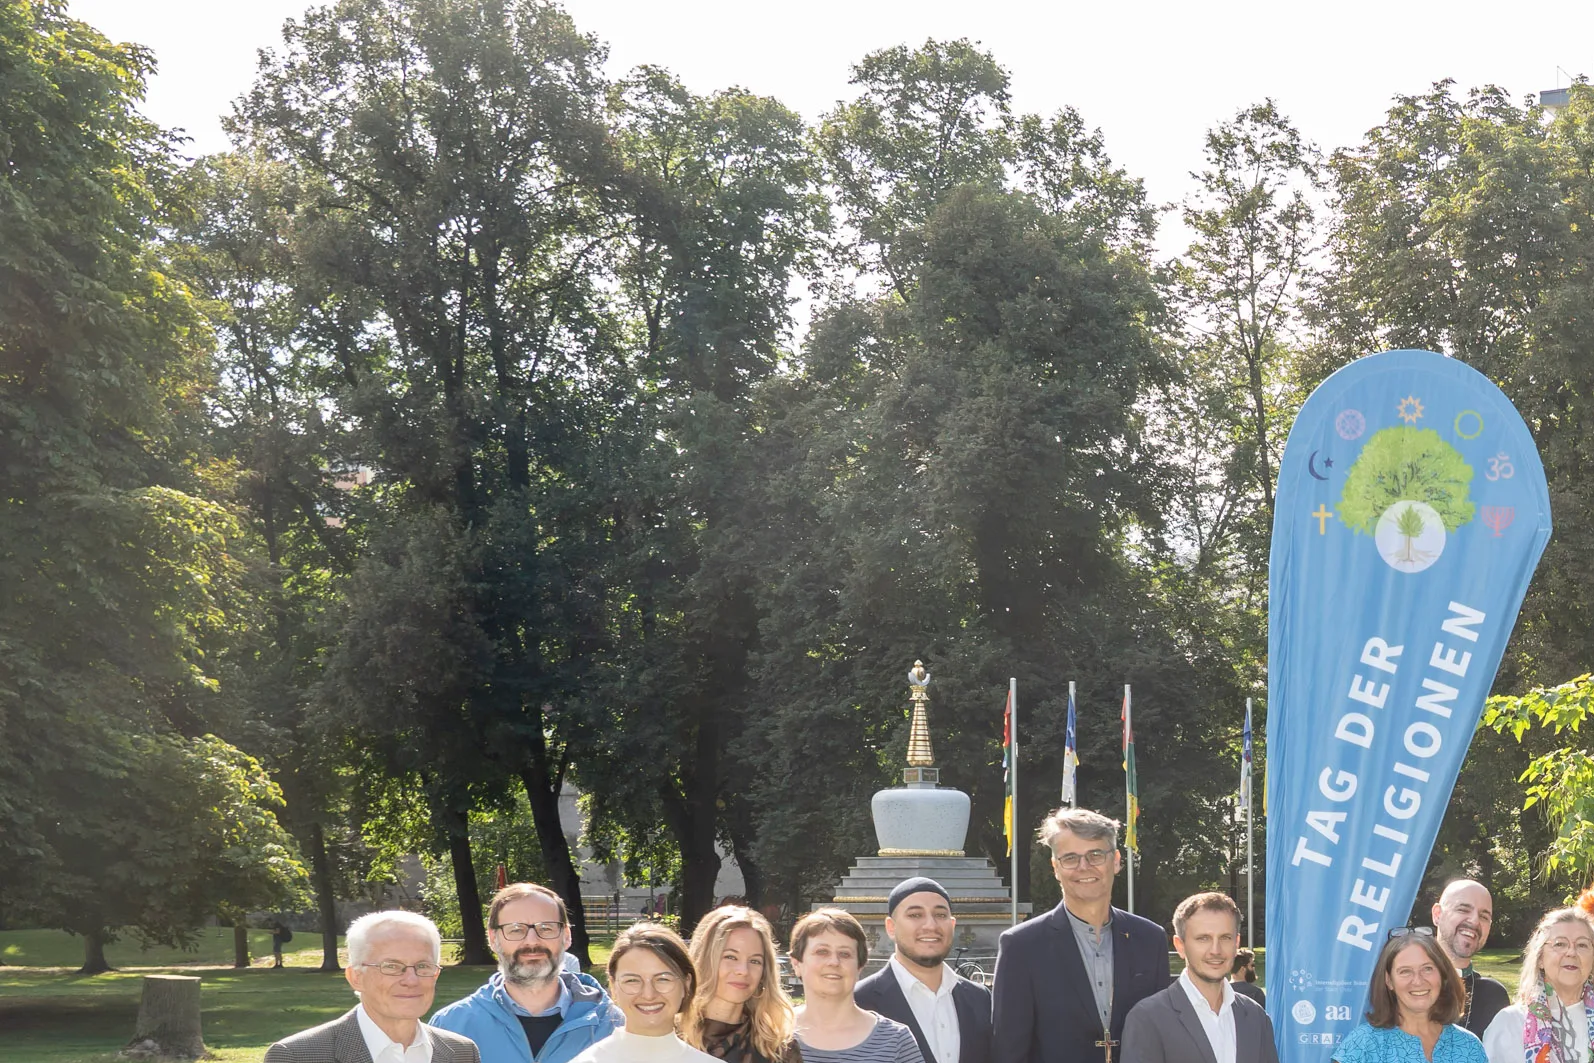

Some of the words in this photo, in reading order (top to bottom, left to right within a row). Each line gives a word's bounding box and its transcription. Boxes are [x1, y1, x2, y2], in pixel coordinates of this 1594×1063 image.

[1291, 766, 1358, 868] TAG
[1334, 636, 1404, 749] DER
[1336, 600, 1486, 952] RELIGIONEN
[1299, 1034, 1342, 1044] GRAZ
[1325, 1005, 1351, 1020] aa
